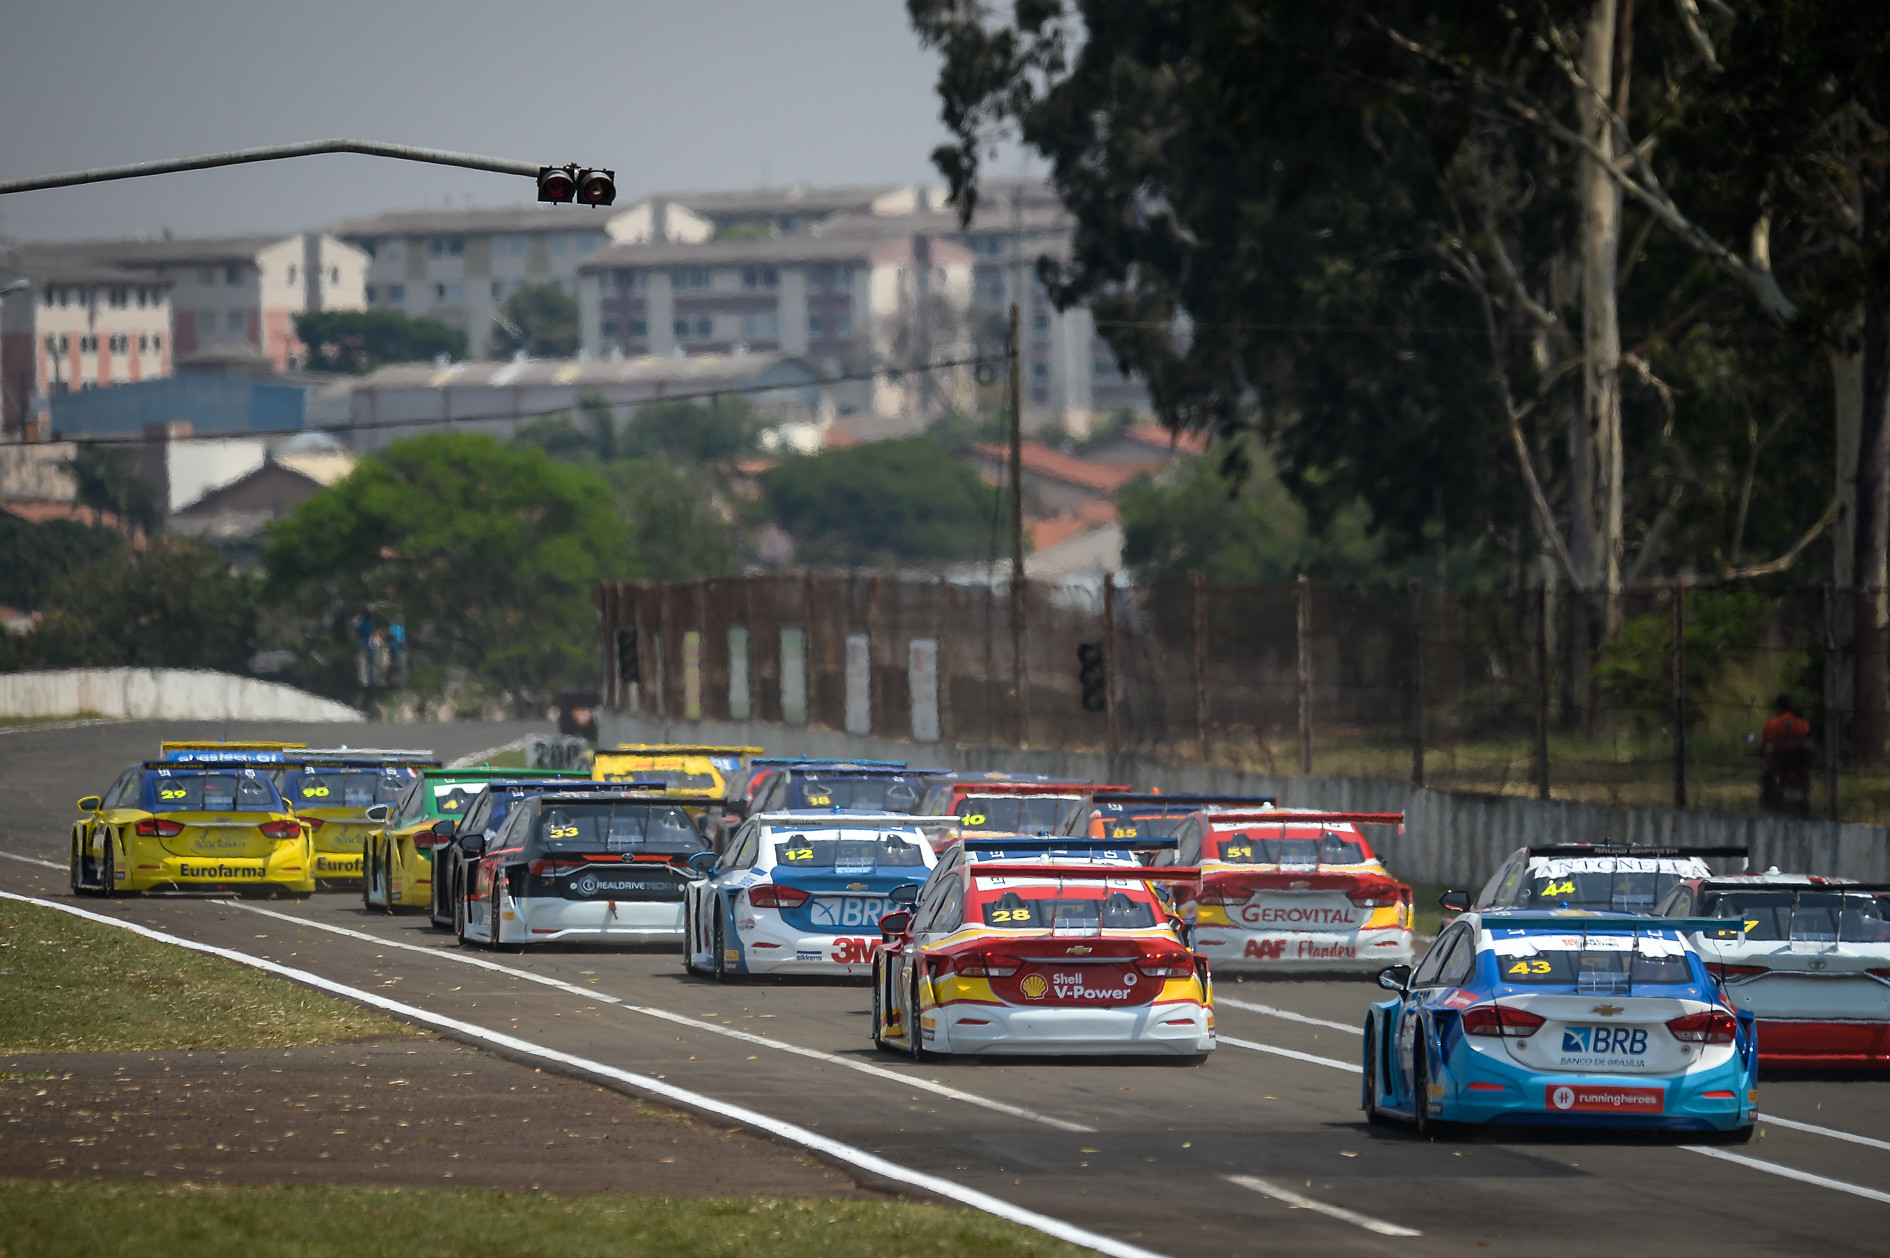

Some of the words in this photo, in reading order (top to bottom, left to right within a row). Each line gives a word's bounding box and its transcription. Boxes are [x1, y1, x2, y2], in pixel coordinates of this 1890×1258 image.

[161, 790, 187, 799] 29
[961, 815, 986, 826] 10
[550, 827, 579, 839] 33
[785, 849, 814, 861] 12
[1227, 847, 1252, 858] 51
[180, 863, 266, 878] Eurofarma
[317, 857, 364, 871] Eurof
[1541, 881, 1576, 897] 44
[992, 909, 1031, 922] 28
[831, 938, 883, 963] 3M
[1508, 960, 1552, 975] 43
[1053, 973, 1083, 985] Shell
[1053, 985, 1131, 999] V-Power
[1592, 1026, 1649, 1056] BRB
[1560, 1057, 1592, 1066] BANCO
[1594, 1058, 1607, 1067] DE
[1608, 1058, 1645, 1068] BRASÍLIA
[1578, 1093, 1657, 1106] runningheroes
